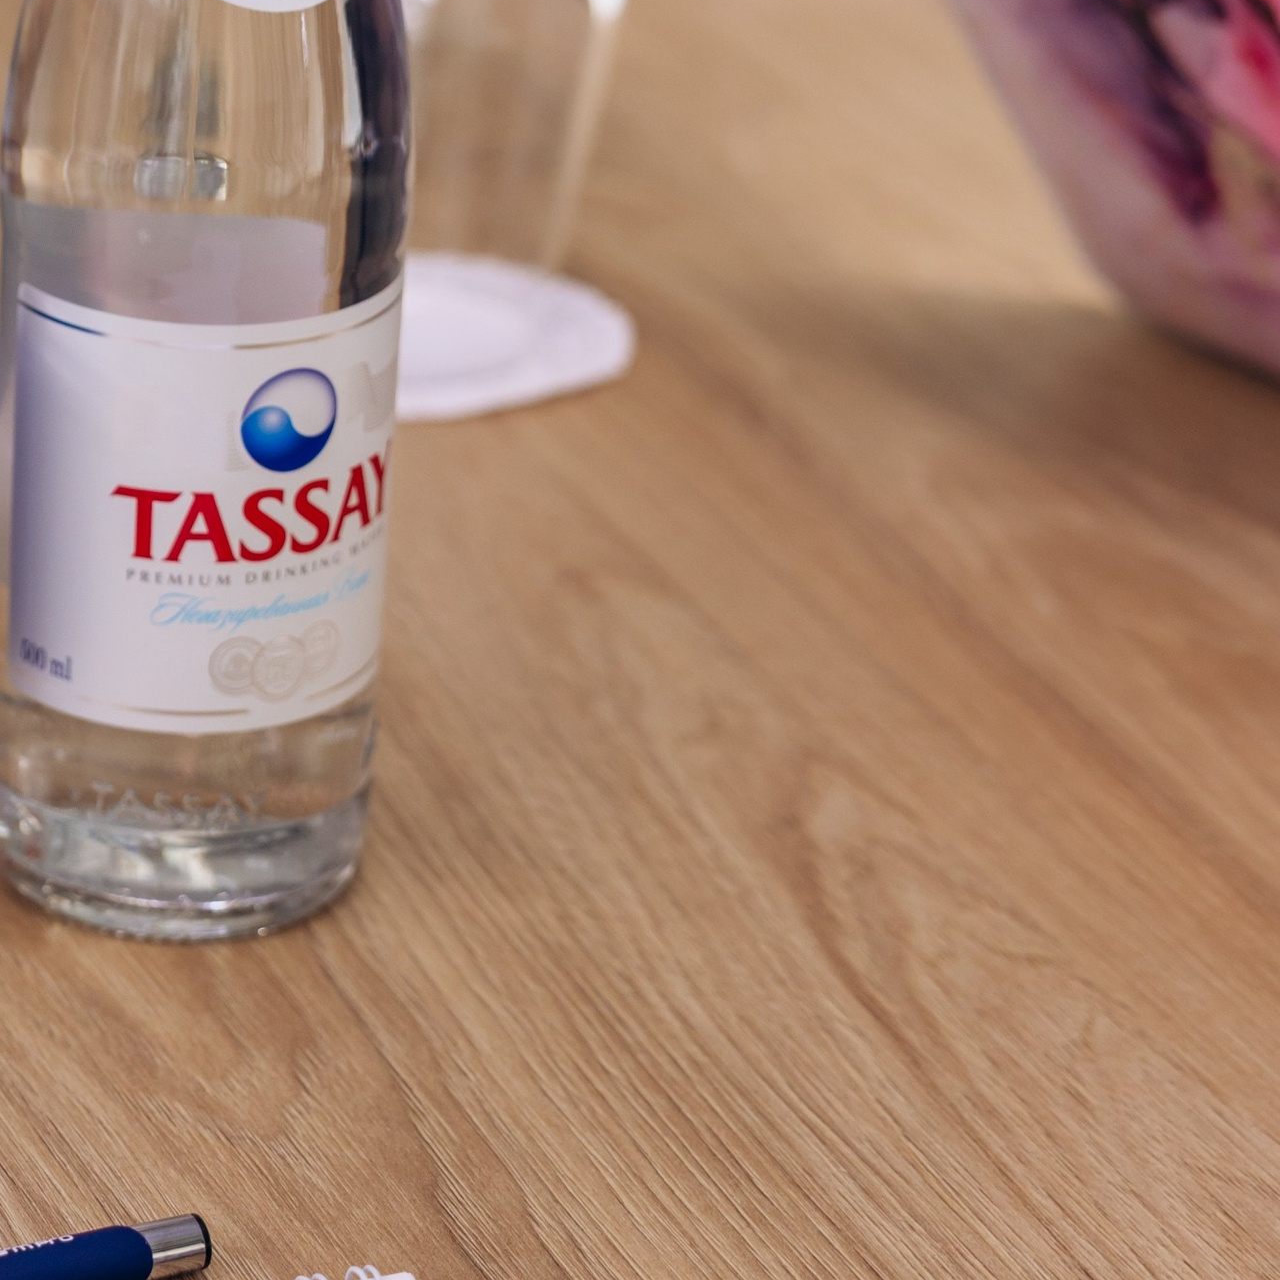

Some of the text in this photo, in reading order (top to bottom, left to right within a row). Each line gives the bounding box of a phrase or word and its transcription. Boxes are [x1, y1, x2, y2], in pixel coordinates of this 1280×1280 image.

[111, 438, 392, 563] TASSAY
[125, 567, 232, 587] PREMIUM
[244, 553, 340, 586] DRINKING
